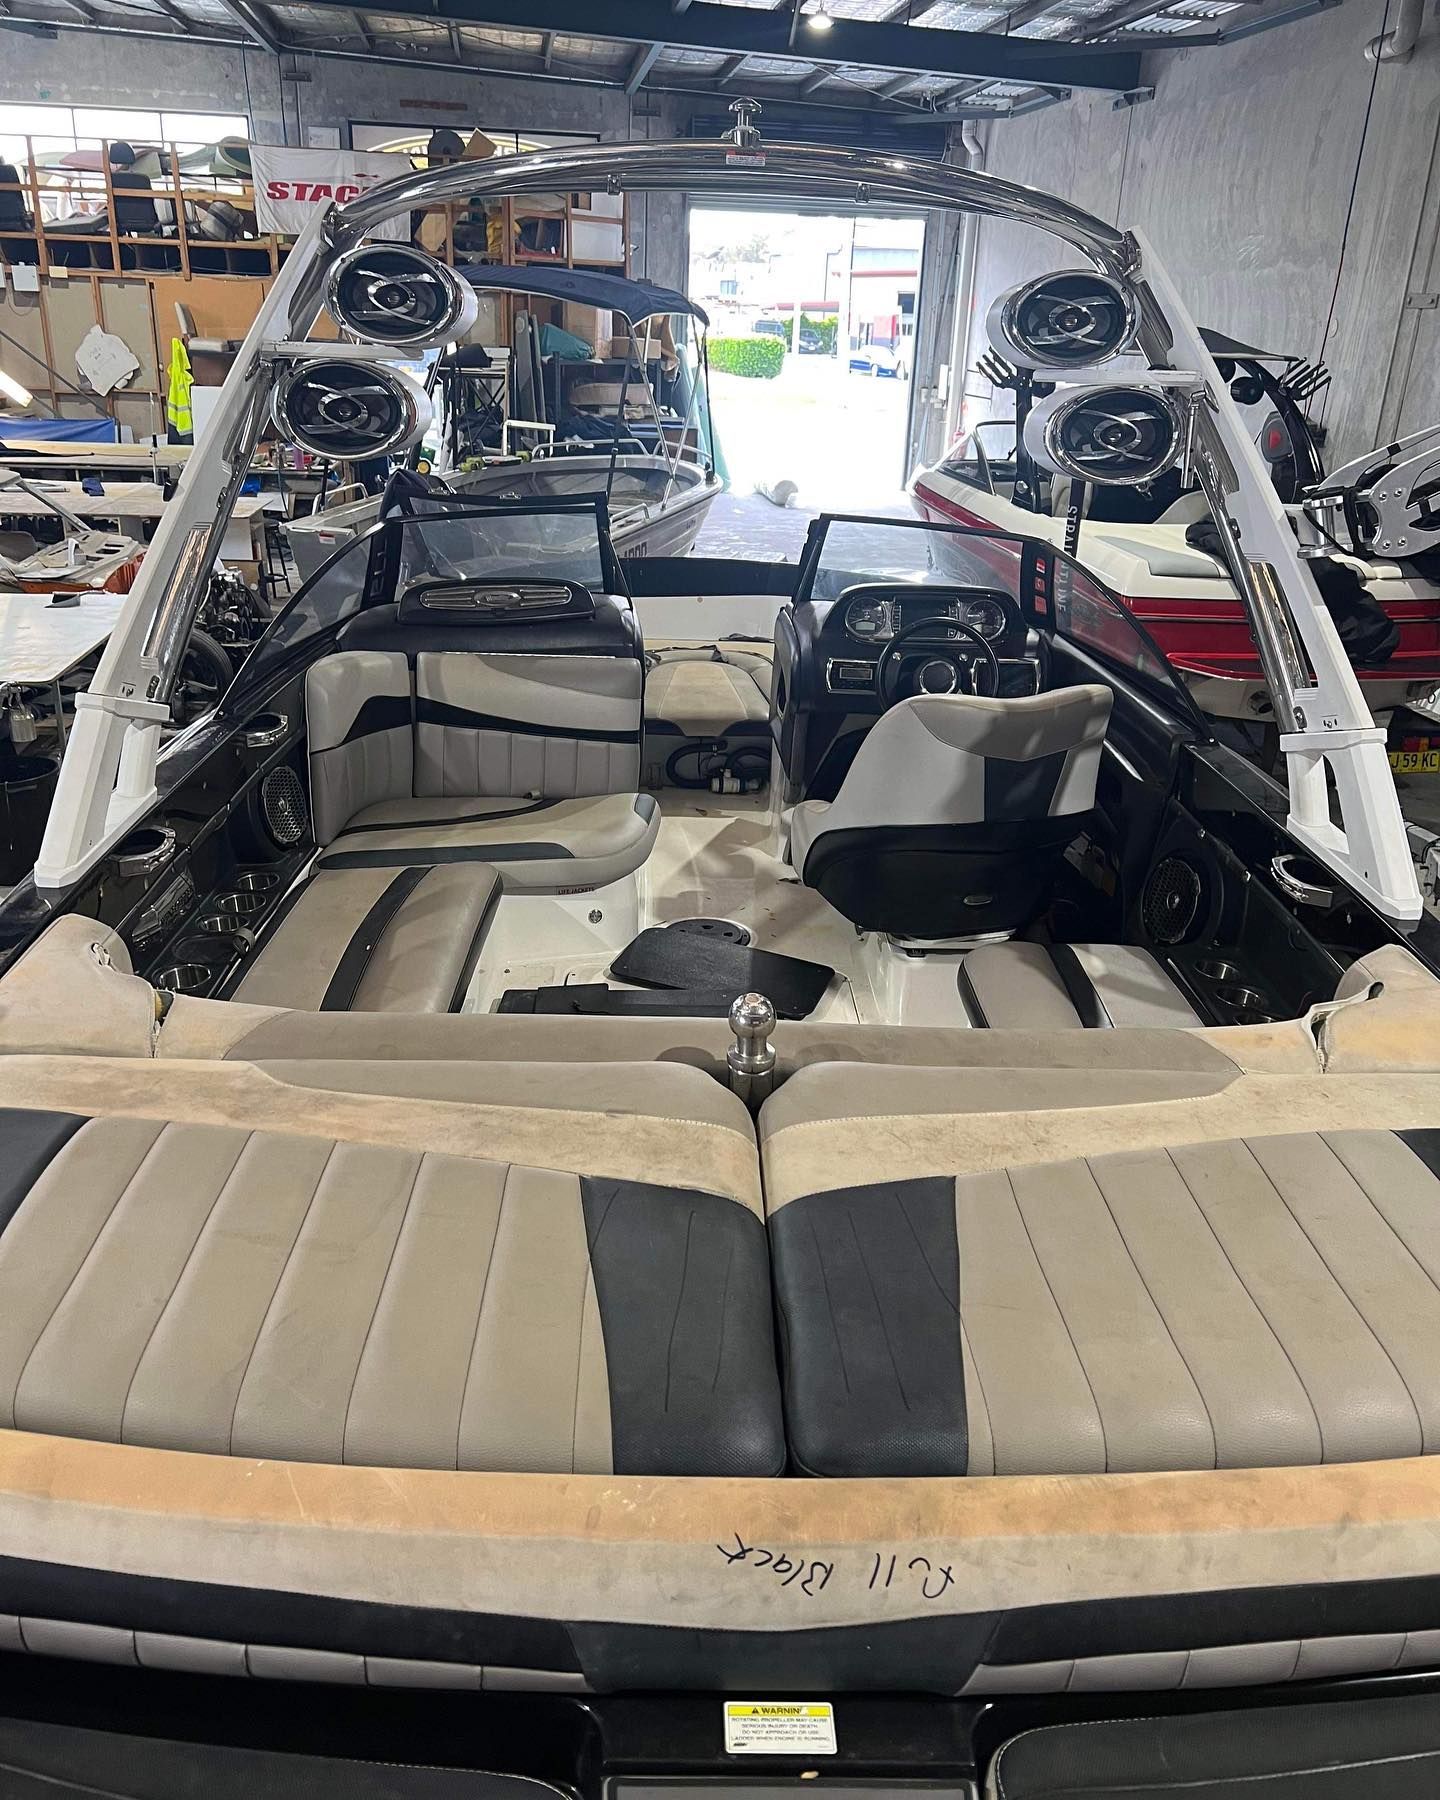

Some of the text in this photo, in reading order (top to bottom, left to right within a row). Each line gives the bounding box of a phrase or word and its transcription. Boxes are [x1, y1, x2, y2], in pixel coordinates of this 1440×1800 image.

[266, 180, 370, 204] STAC
[1402, 753, 1417, 768] 59
[1421, 752, 1437, 768] KC
